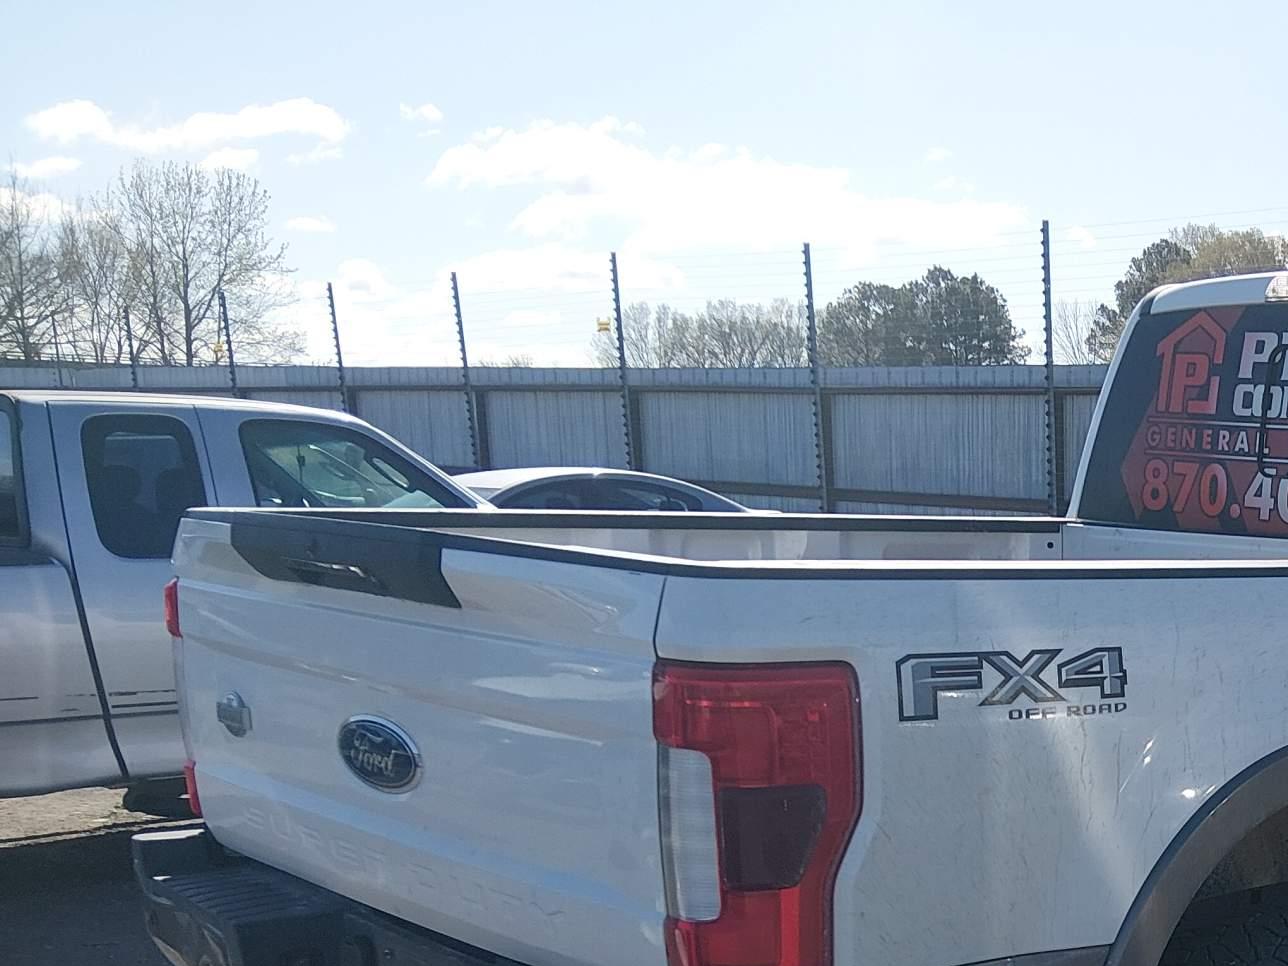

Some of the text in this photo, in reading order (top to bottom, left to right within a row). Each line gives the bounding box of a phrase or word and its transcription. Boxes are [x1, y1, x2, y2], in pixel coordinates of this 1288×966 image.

[1146, 426, 1270, 454] GENERAL
[896, 646, 1128, 722] FX4
[1008, 702, 1127, 720] OFF ROAD
[350, 731, 403, 777] Ford
